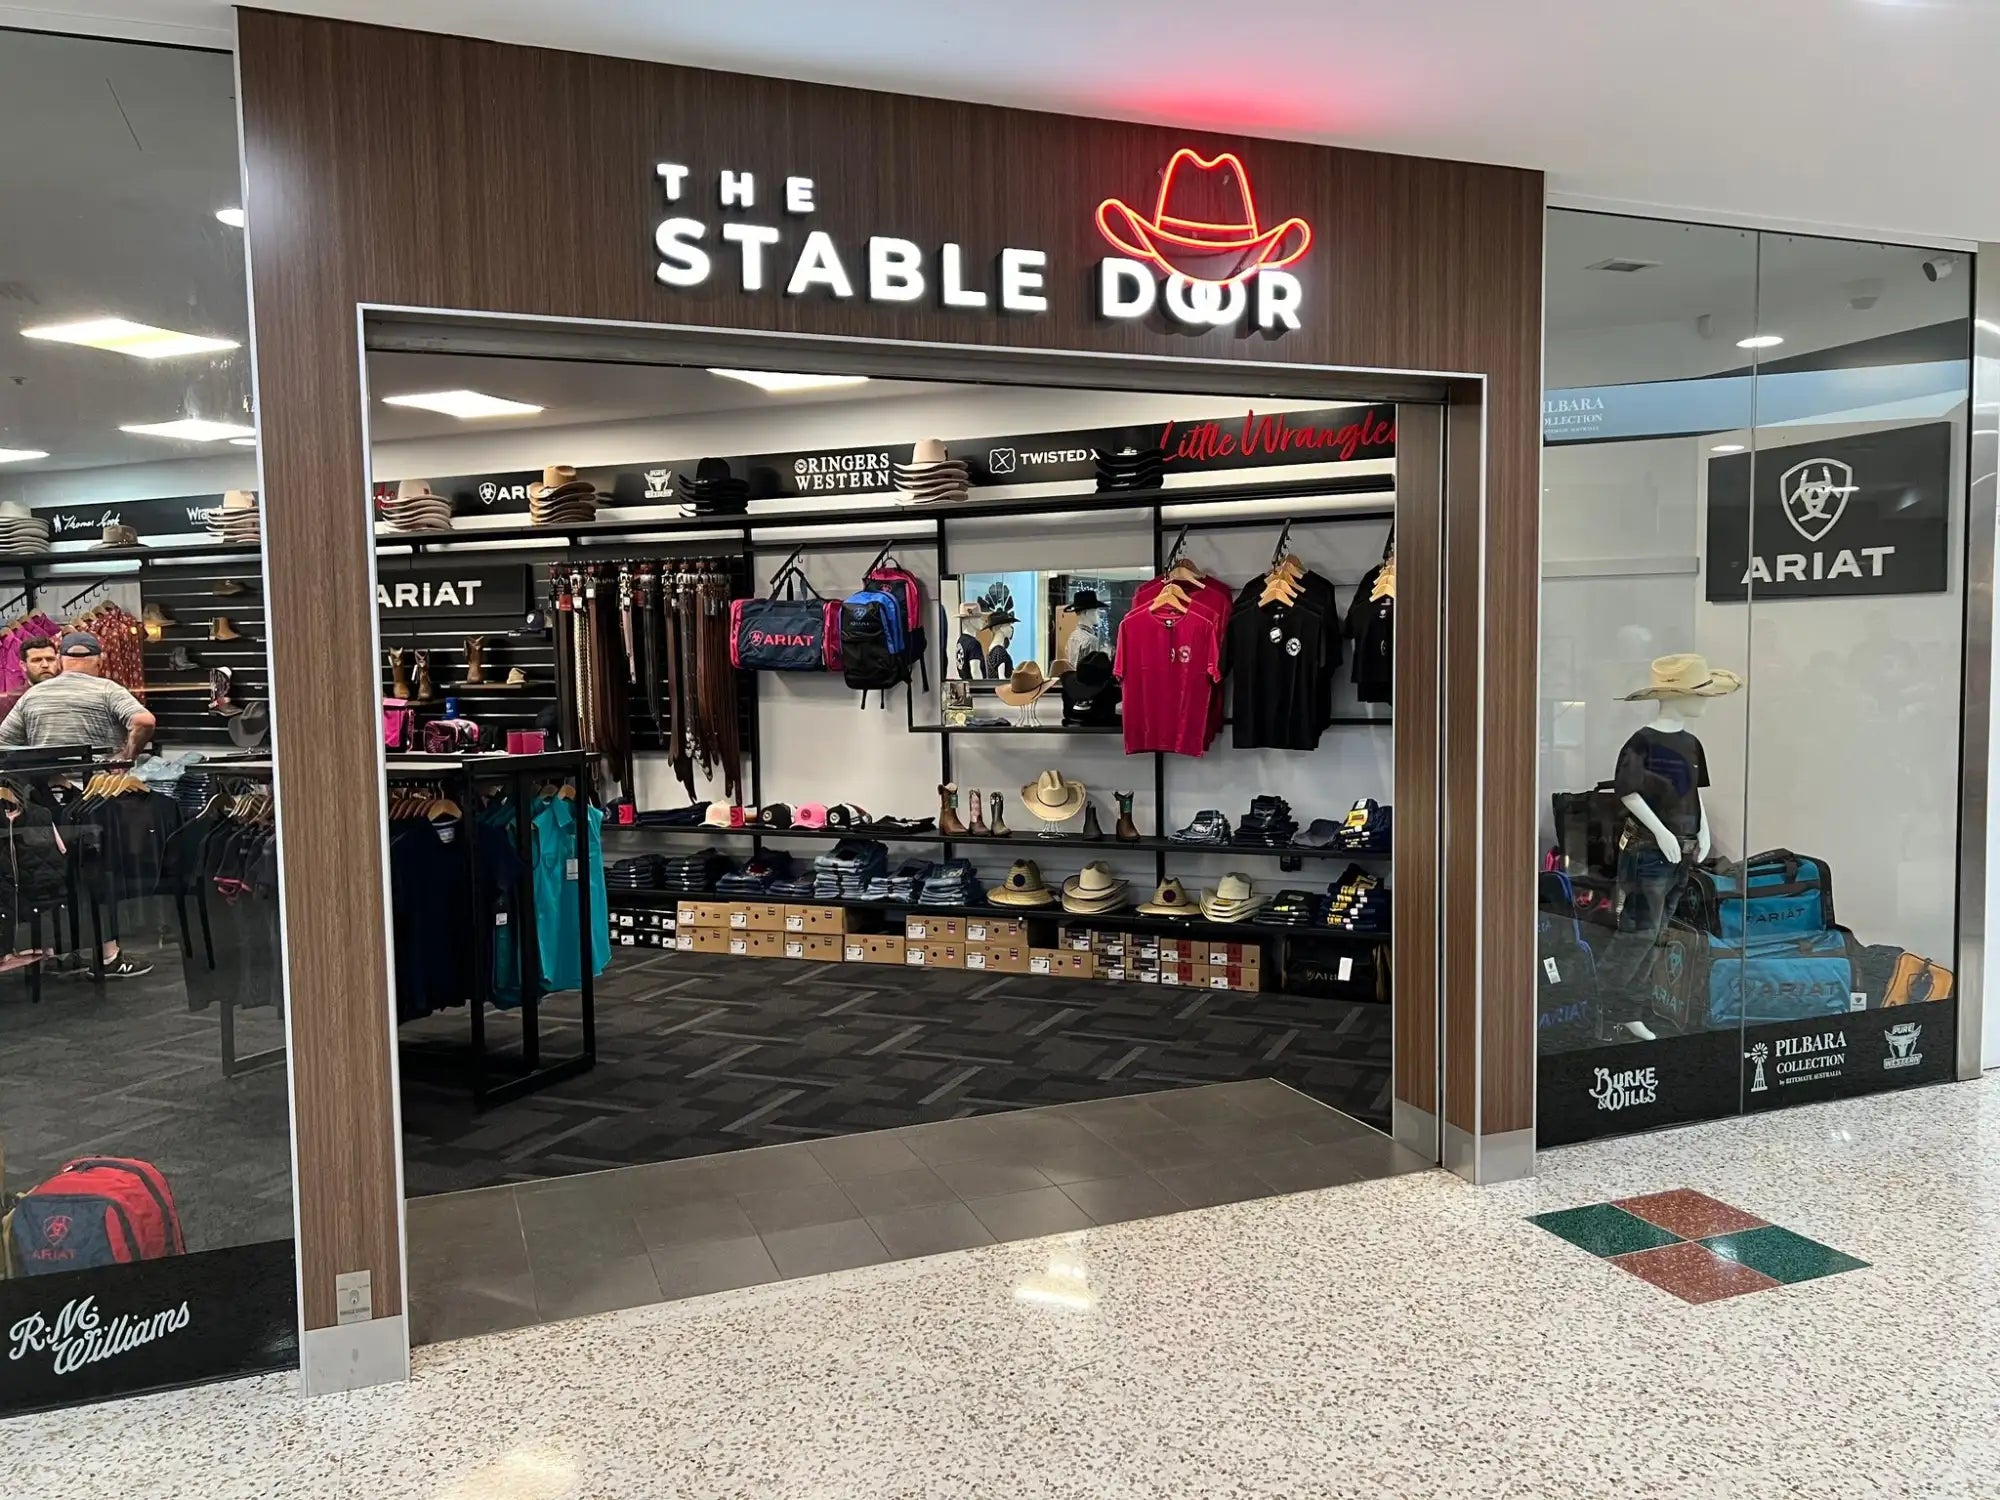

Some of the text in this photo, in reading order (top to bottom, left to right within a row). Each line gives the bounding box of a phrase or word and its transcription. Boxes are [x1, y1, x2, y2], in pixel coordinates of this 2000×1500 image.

[656, 163, 815, 213] THE
[655, 216, 1303, 330] STABLE DOOR
[1543, 397, 1604, 413] ILBARA
[1160, 409, 1396, 461] Little Wrangle
[807, 453, 890, 473] RINGERS
[1020, 449, 1087, 465] TWISTED
[795, 470, 890, 490] WESTERN
[1740, 546, 1896, 584] ARIAT
[376, 580, 482, 608] ARIAT
[763, 633, 815, 647] ARIAT
[1755, 907, 1805, 924] ARIAT
[1761, 981, 1840, 998] ARIAT
[1775, 1031, 1847, 1057] PILBARA
[1776, 1053, 1845, 1074] COLLECTION
[52, 1301, 190, 1375] Williams
